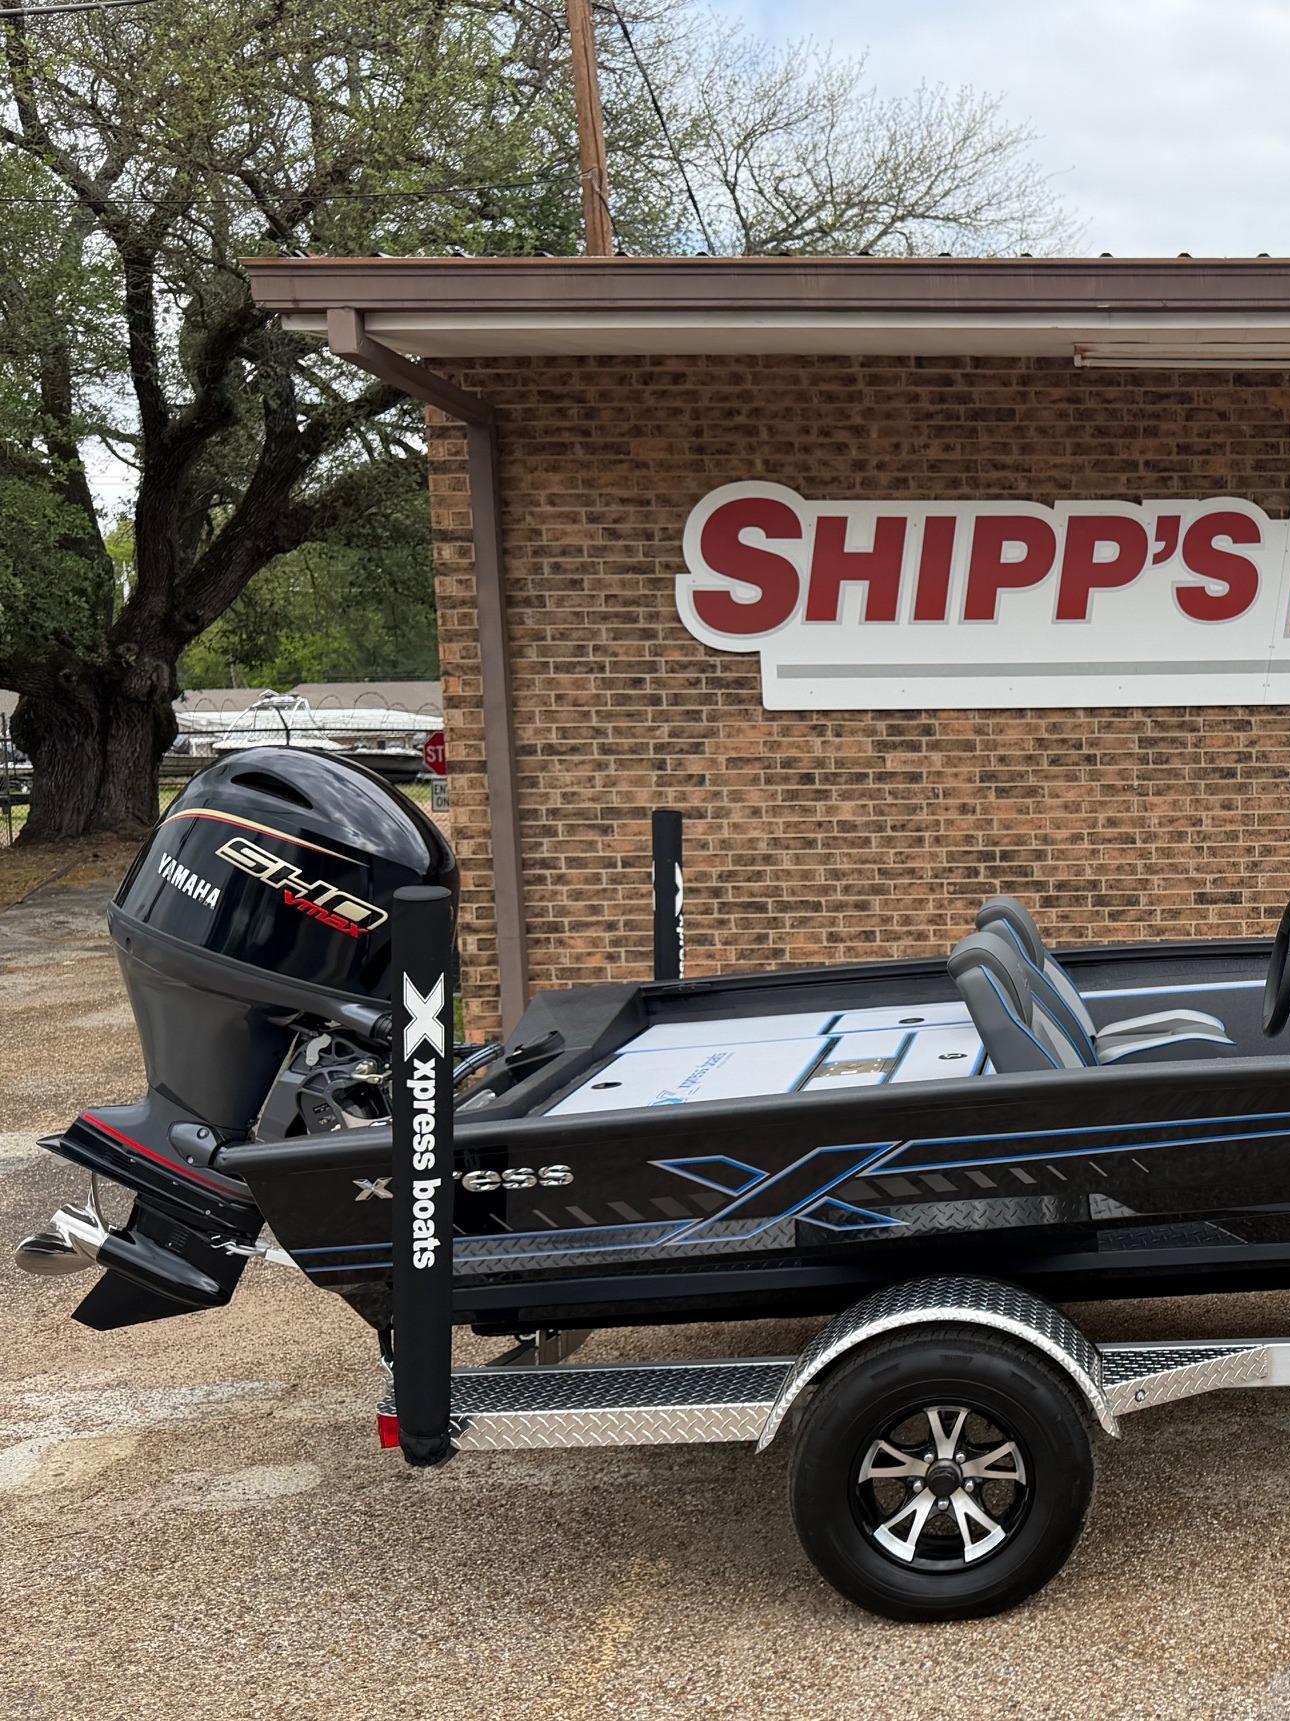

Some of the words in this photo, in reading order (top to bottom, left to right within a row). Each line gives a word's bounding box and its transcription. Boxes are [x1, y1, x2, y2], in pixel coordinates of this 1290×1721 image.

[691, 497, 1262, 635] SHIPP'S
[426, 745, 444, 763] ST
[155, 852, 222, 910] YAMAHA
[214, 837, 389, 931] SHO
[406, 1057, 436, 1171] xpress
[352, 1164, 575, 1202] xess
[412, 1178, 442, 1270] boats
